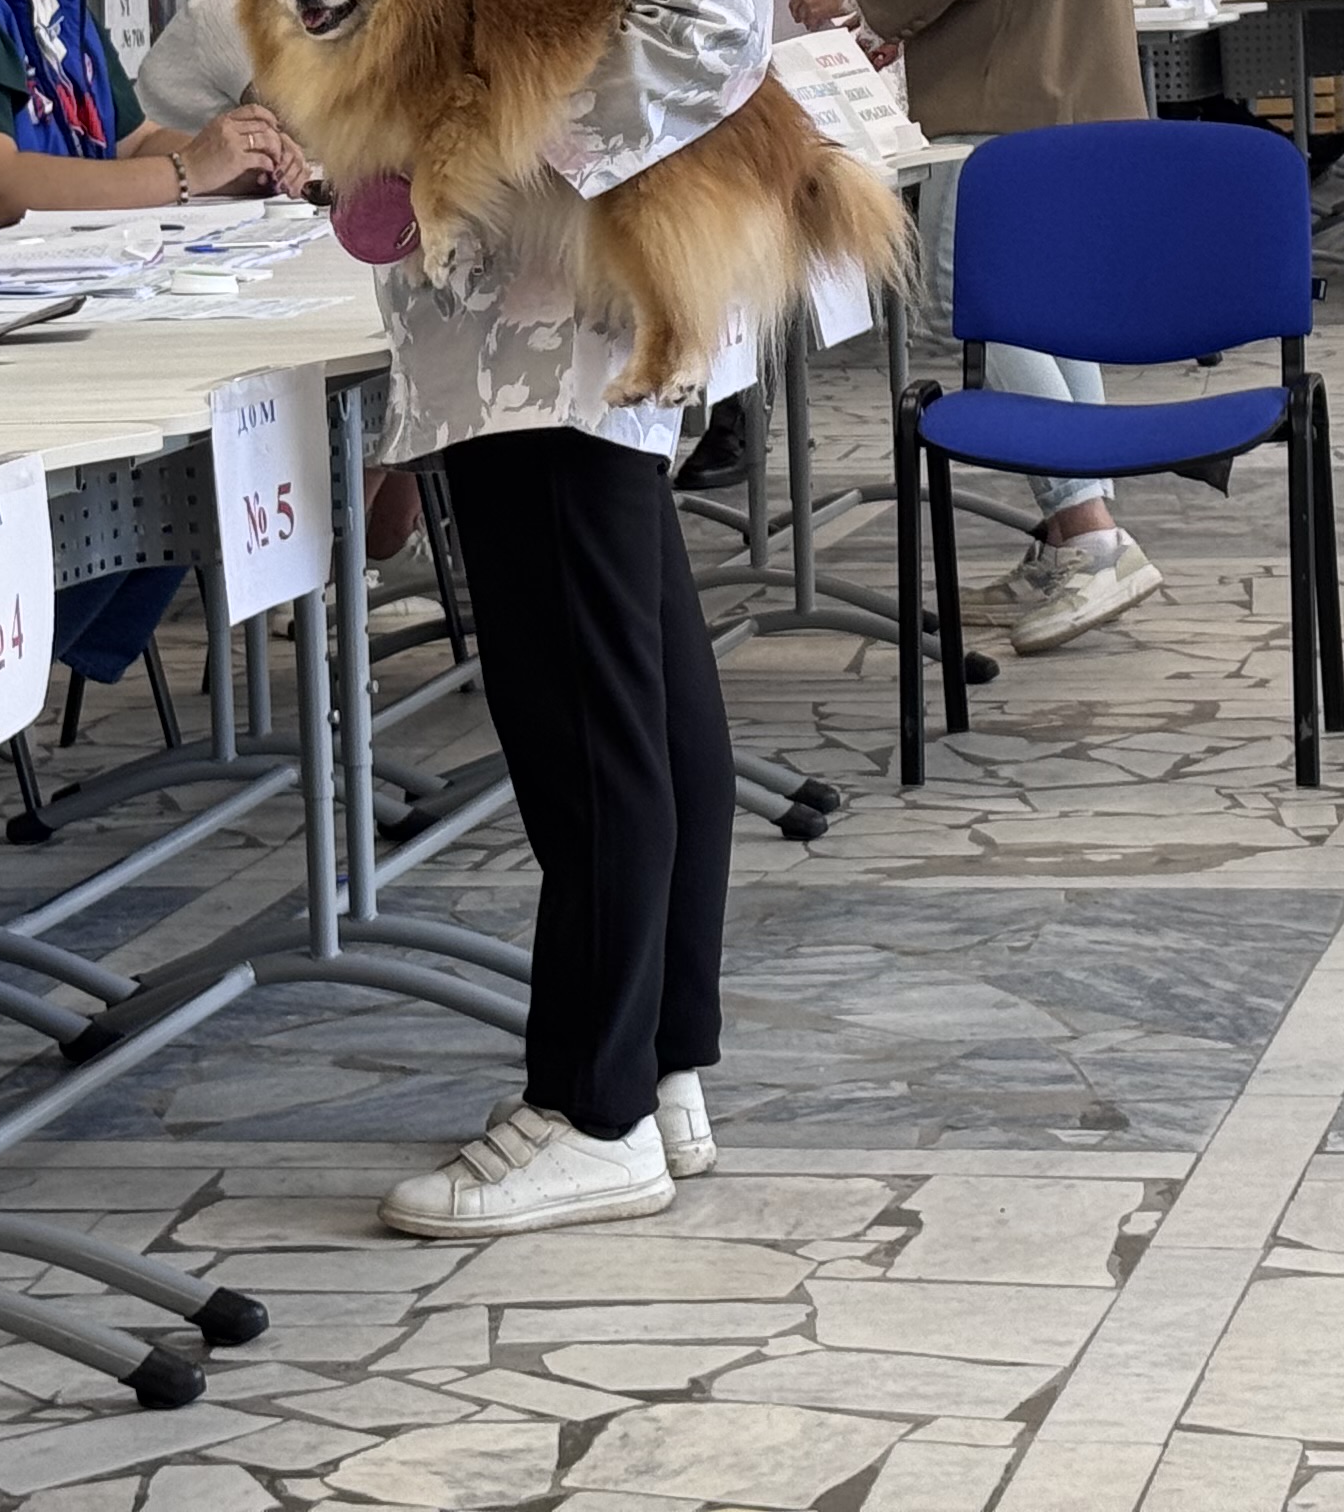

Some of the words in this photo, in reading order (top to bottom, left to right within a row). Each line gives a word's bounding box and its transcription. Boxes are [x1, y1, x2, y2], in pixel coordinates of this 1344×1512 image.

[238, 398, 277, 436] ДОМ
[243, 491, 270, 555] №
[276, 481, 295, 541] 5
[11, 593, 24, 660] 4
